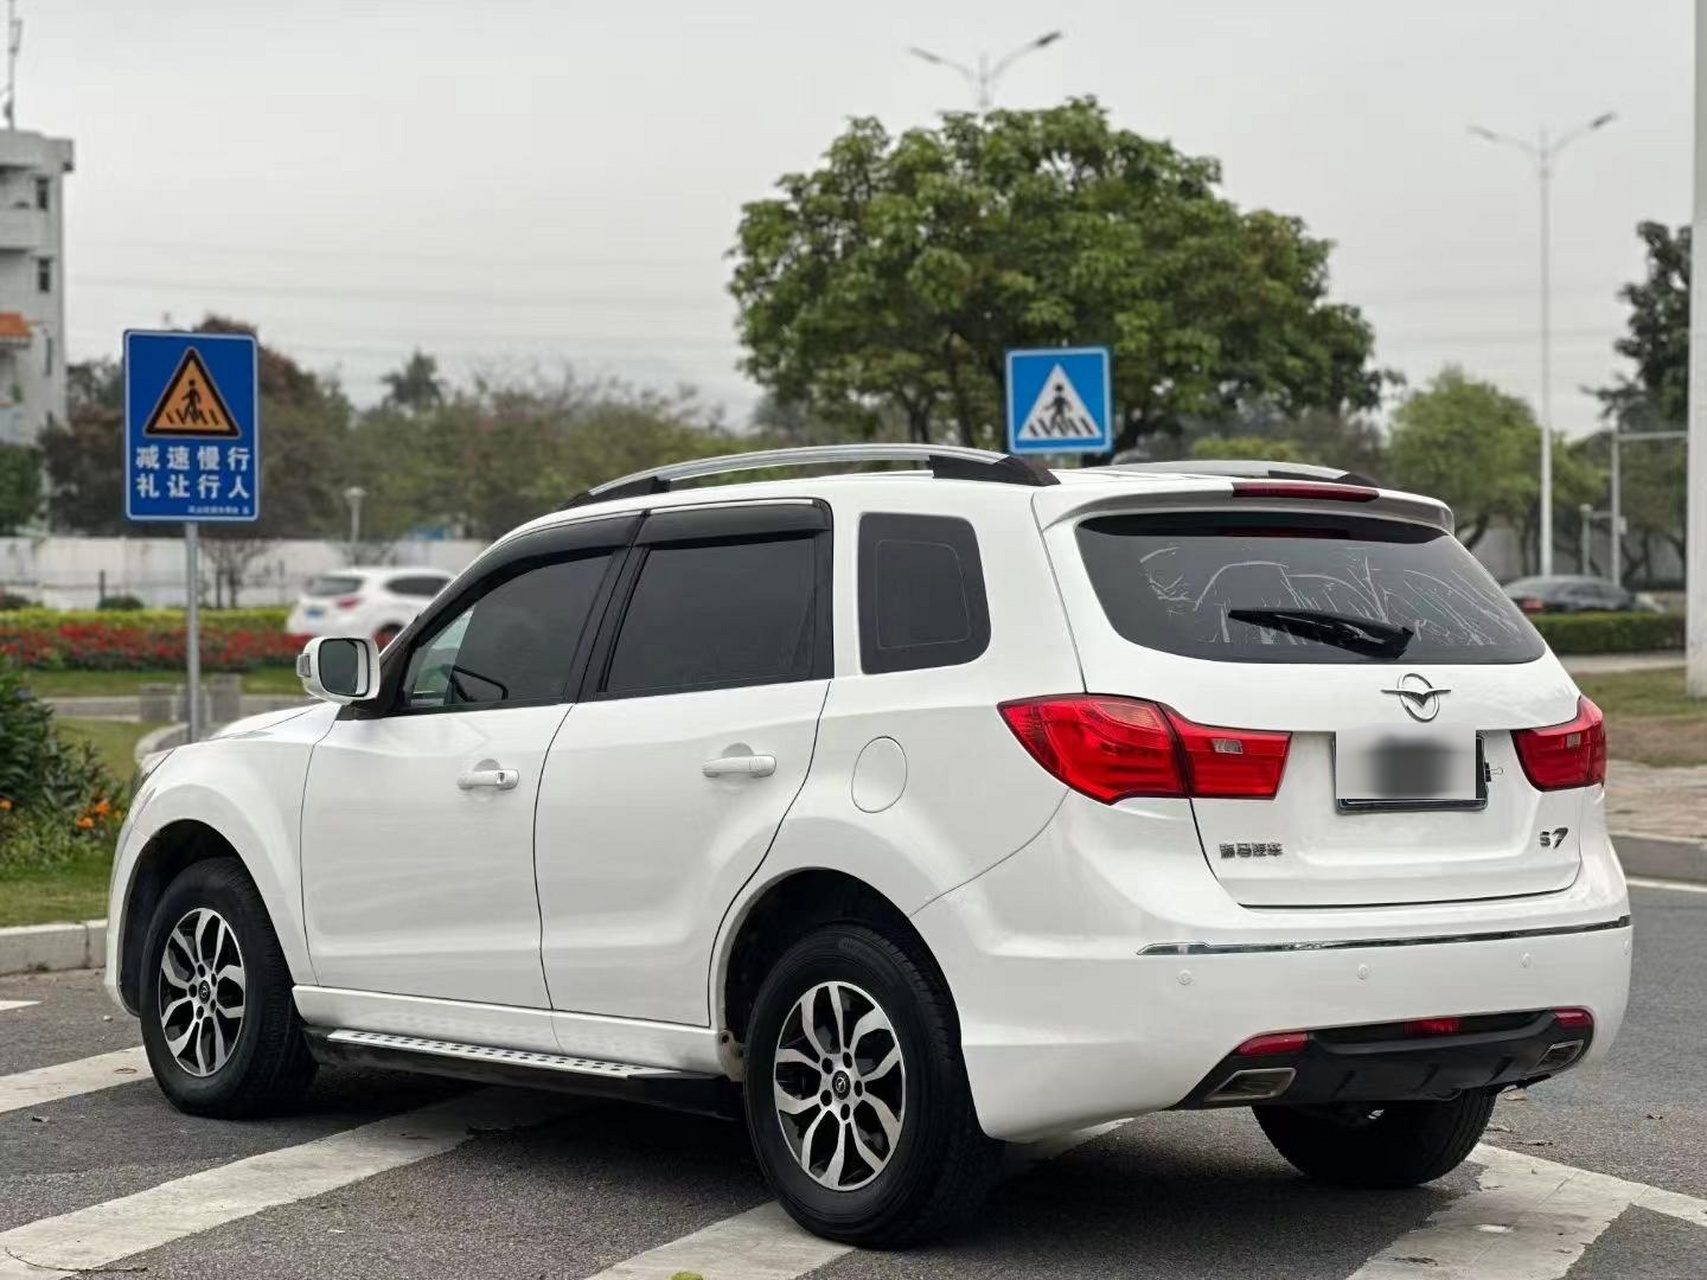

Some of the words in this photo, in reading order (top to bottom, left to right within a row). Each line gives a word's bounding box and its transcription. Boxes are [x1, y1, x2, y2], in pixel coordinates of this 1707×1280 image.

[136, 445, 250, 471] 减速慢行
[136, 473, 250, 499] 礼让行人
[1540, 827, 1569, 849] S7
